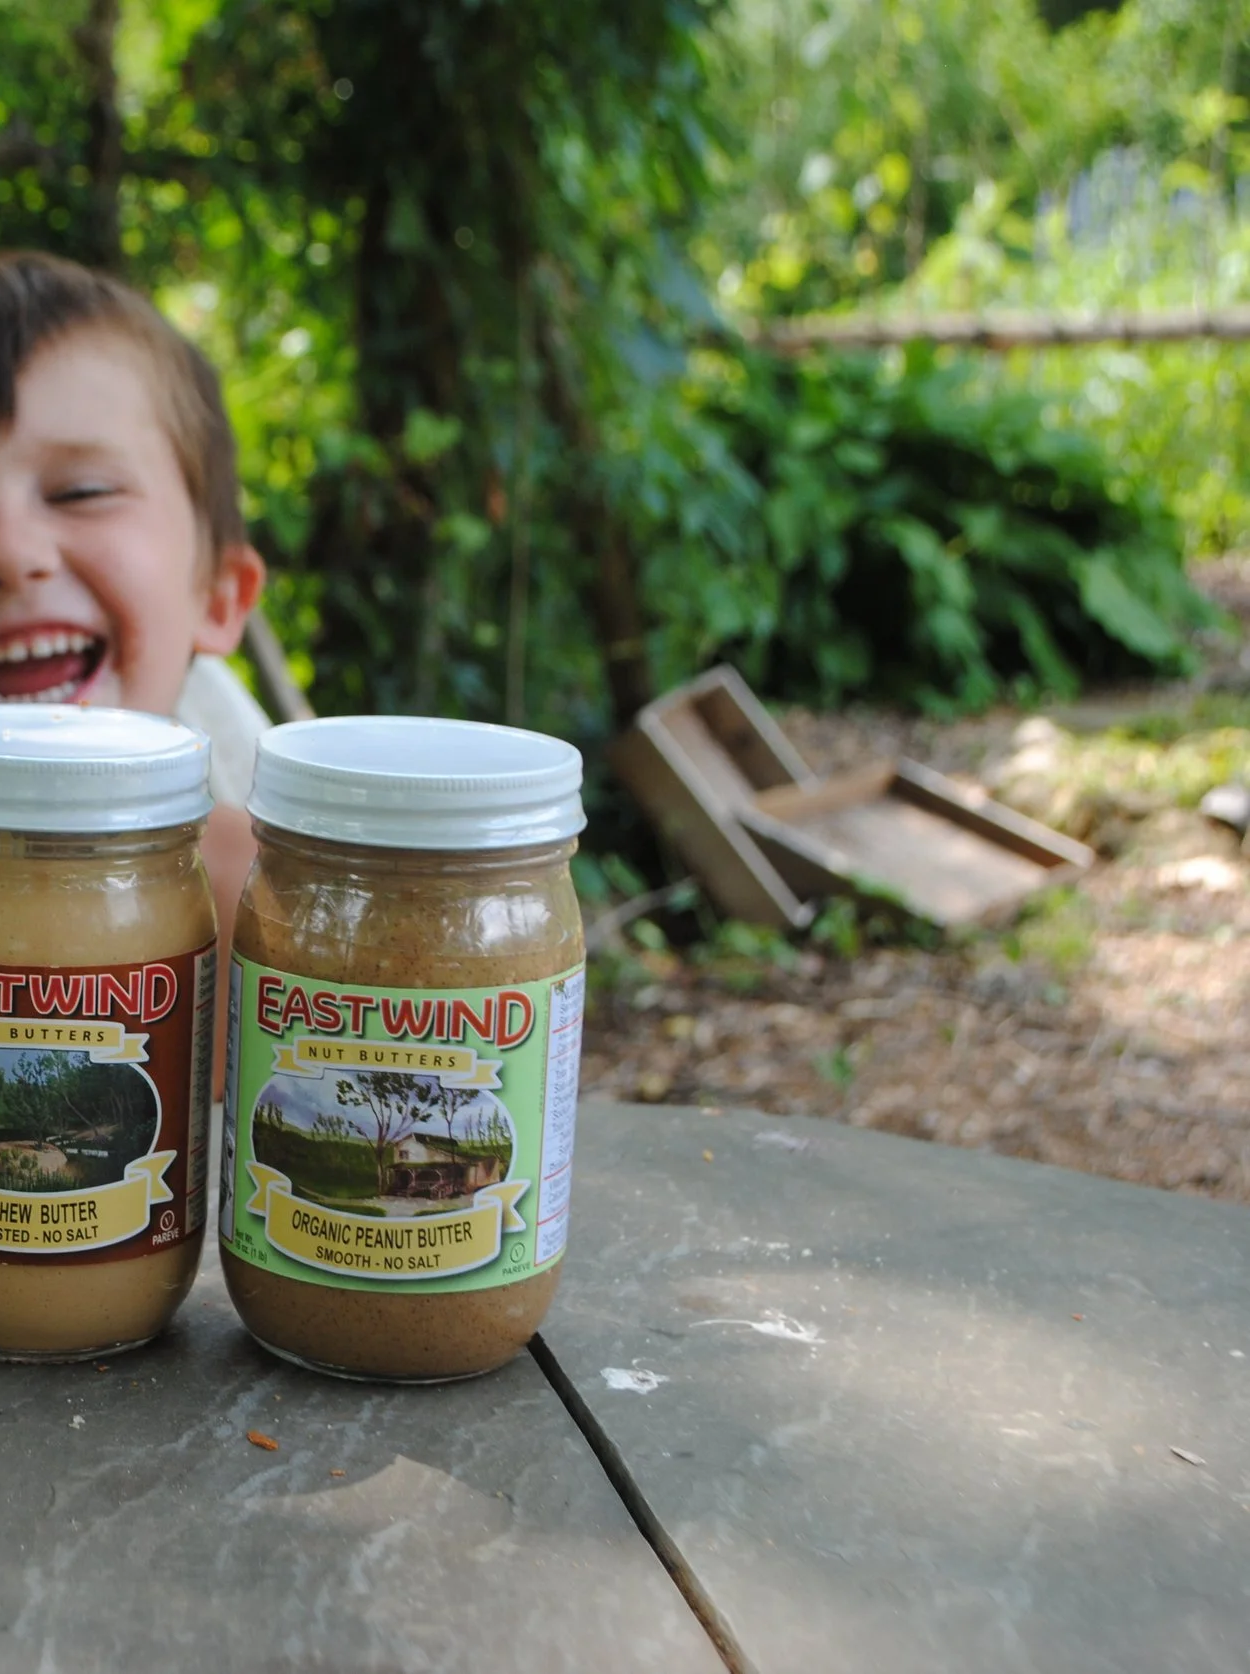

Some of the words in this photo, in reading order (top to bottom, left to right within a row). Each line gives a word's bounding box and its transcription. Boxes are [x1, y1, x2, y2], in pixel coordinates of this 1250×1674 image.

[10, 1027, 106, 1043] BUTTERS
[309, 1046, 344, 1060] NUT
[359, 1049, 456, 1068] BUTTERS
[41, 1200, 98, 1225] BUTTER
[42, 1229, 63, 1243] NO
[66, 1225, 99, 1241] SALT
[152, 1228, 179, 1246] PAREVE
[292, 1208, 350, 1246] ORGANIC
[355, 1225, 412, 1250] PEANUT
[418, 1221, 473, 1248] BUTTER
[315, 1246, 371, 1269] SMOOTH
[383, 1255, 404, 1270] NO
[408, 1254, 441, 1269] SALT
